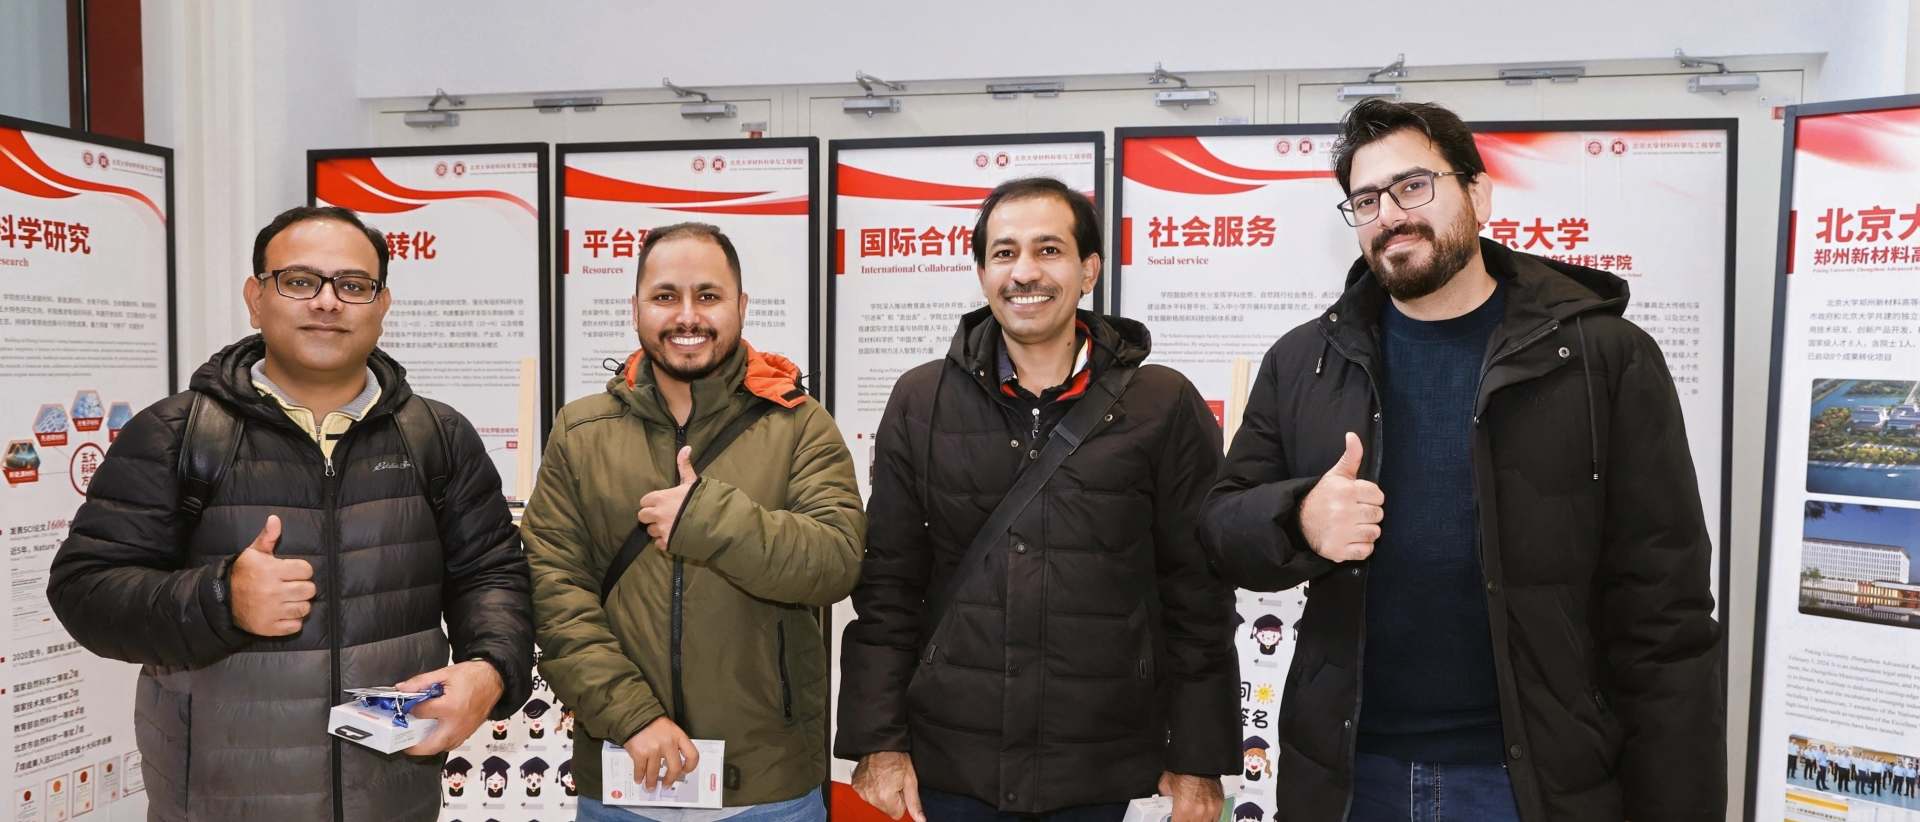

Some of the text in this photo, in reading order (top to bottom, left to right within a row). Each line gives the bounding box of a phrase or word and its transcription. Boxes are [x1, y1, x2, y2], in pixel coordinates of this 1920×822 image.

[386, 231, 436, 260] 转化
[860, 225, 974, 258] 国际合作
[1148, 215, 1276, 248] 社会服务
[1479, 217, 1589, 250] 京大学
[582, 265, 624, 275] Resources
[861, 263, 972, 274] International Collabration
[1148, 256, 1209, 265] Social service
